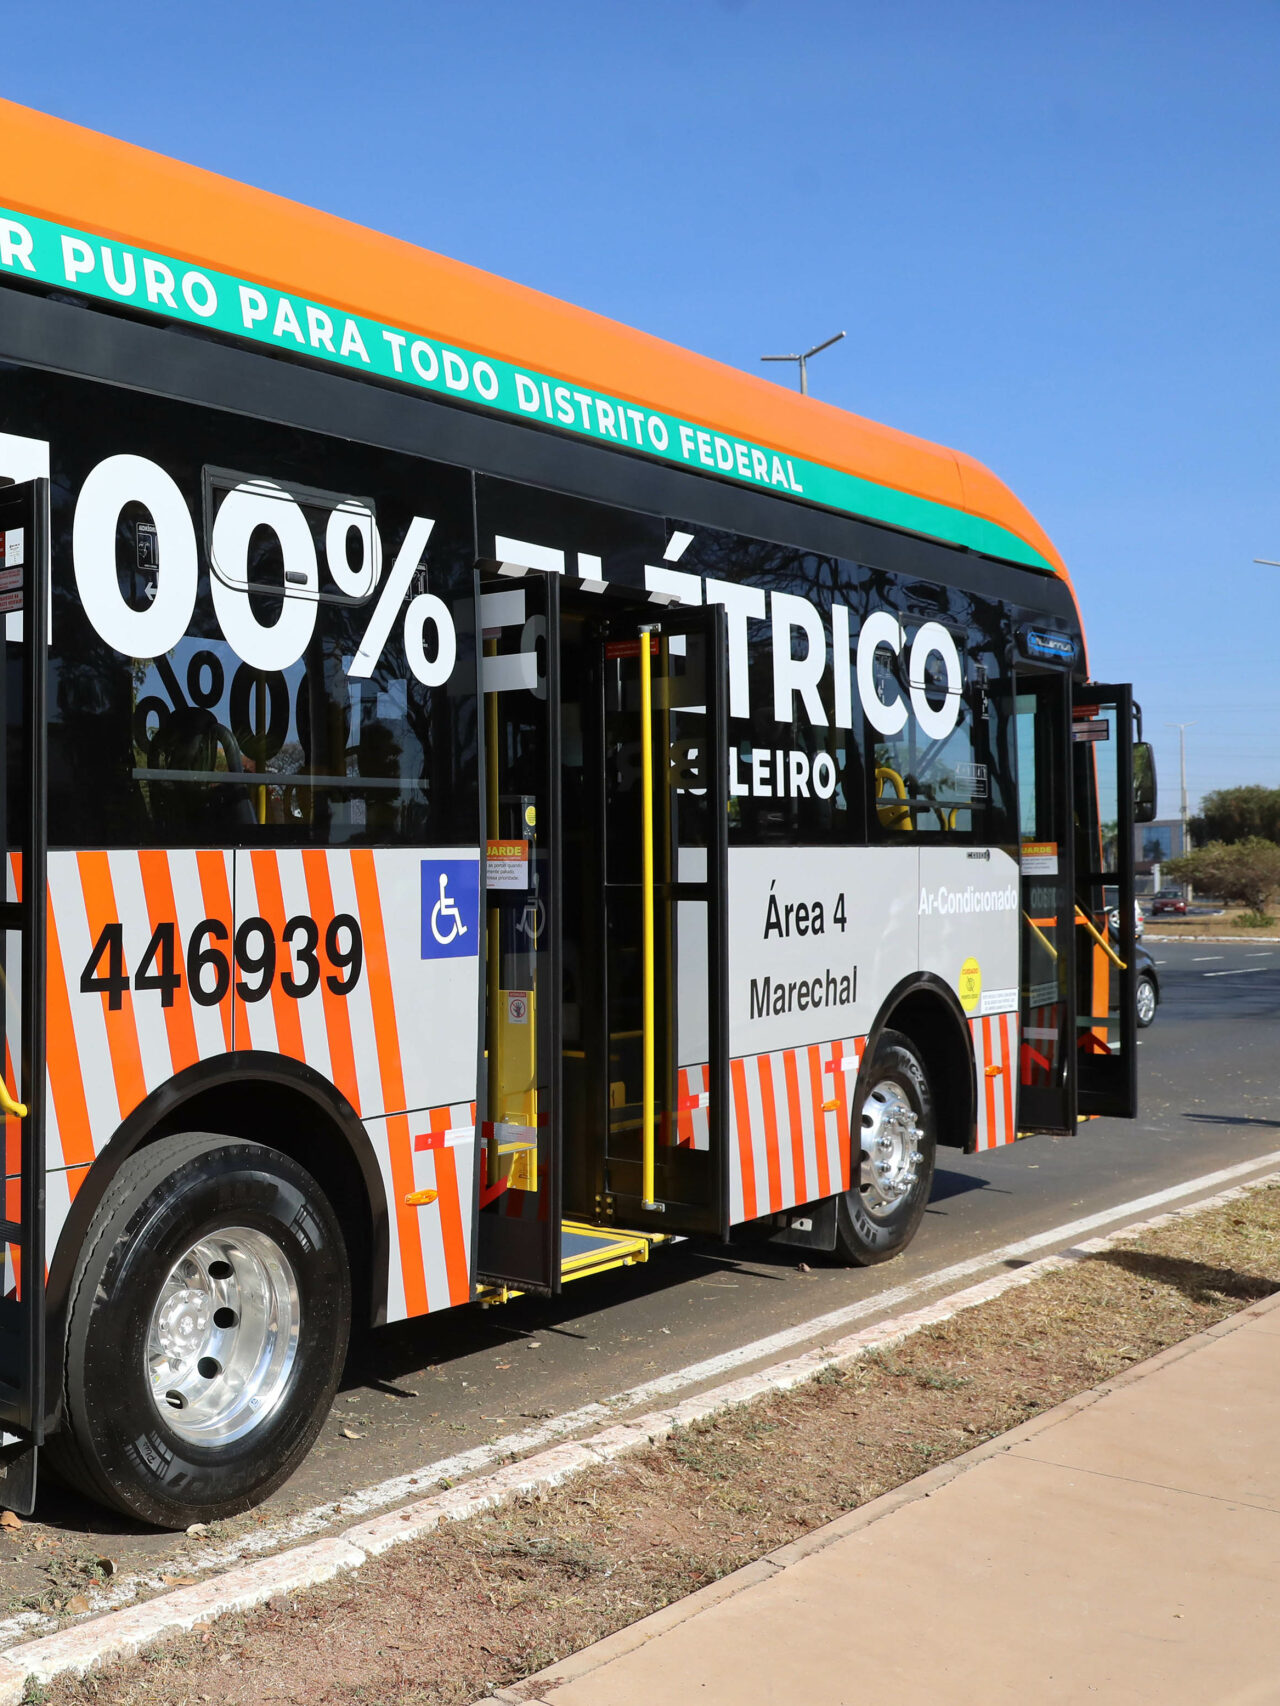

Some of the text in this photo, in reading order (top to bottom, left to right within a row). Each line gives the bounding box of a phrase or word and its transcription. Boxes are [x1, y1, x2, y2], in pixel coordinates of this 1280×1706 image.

[61, 234, 218, 318] PURO
[237, 284, 370, 363] PARA
[382, 330, 499, 401] TODO
[515, 372, 669, 452] DISTRITO
[679, 424, 803, 493] FEDERAL
[763, 879, 848, 940] Área 4
[80, 914, 363, 1011] 446939
[749, 965, 858, 1019] Marechal
